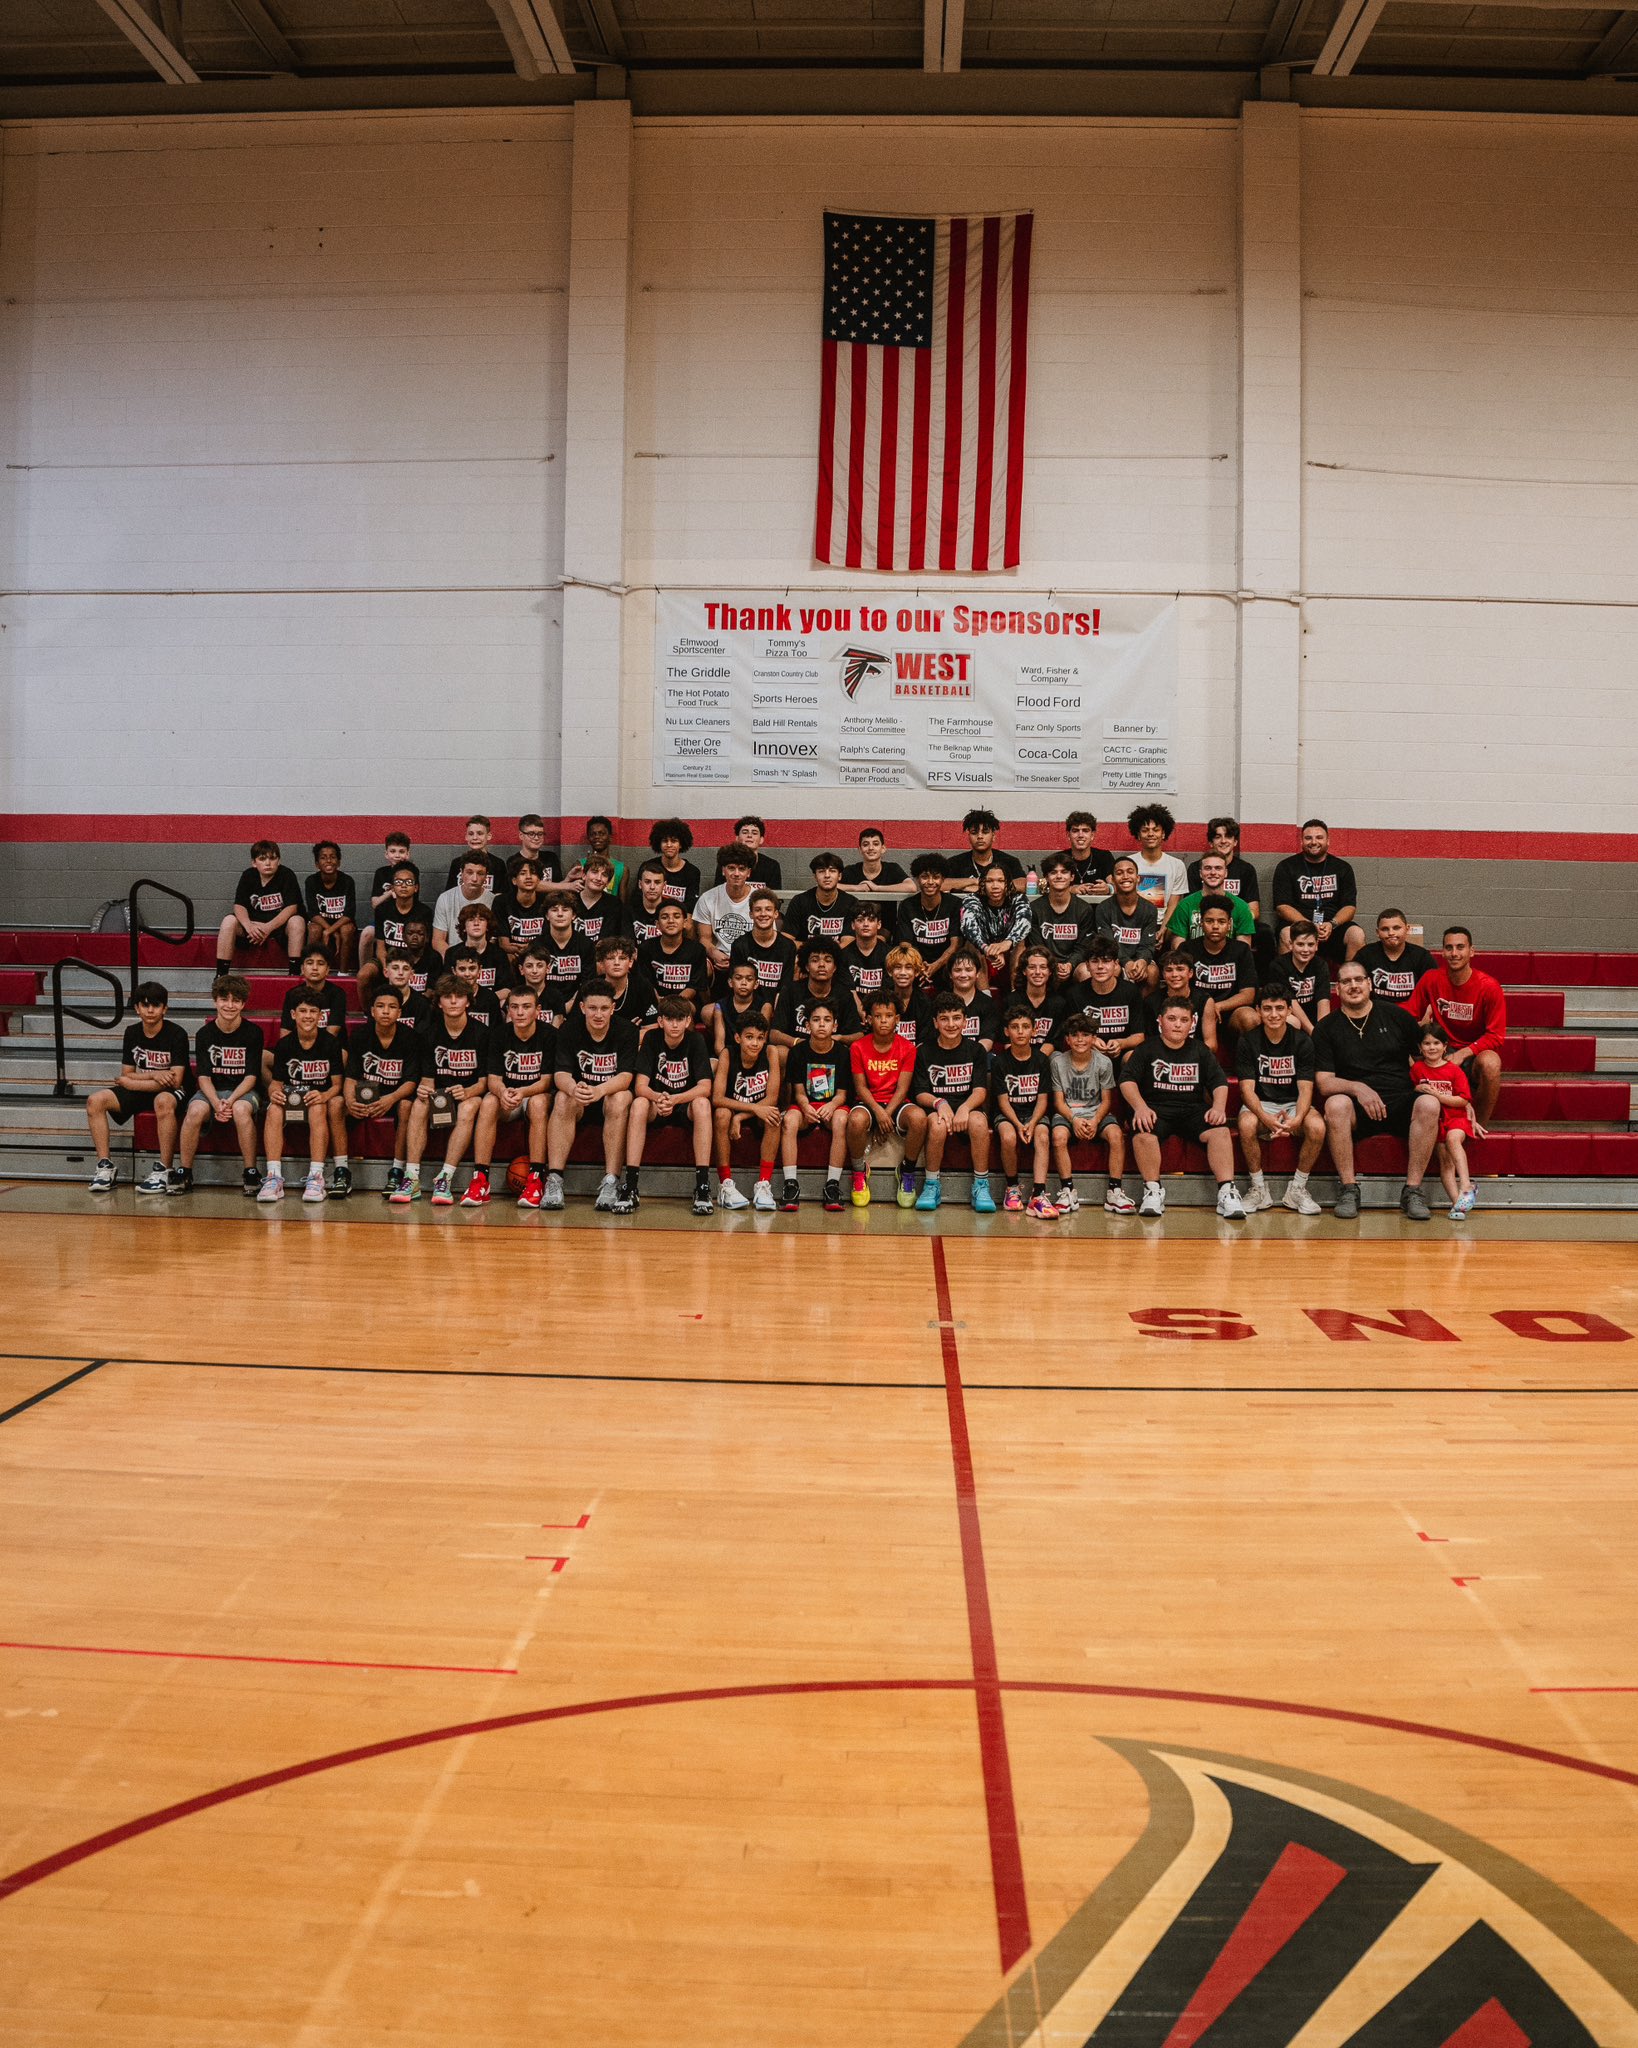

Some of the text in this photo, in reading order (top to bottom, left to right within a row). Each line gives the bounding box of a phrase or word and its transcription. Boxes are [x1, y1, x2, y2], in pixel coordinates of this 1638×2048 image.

[704, 603, 1100, 636] Thank you to our Sponsors!
[680, 638, 718, 646] Elmwood
[768, 639, 806, 648] Tommy's
[673, 646, 725, 654] Sportscenter
[896, 653, 971, 680] WEST
[667, 668, 730, 678] The Griddle
[781, 670, 804, 678] Country
[895, 685, 971, 696] BASKETBALL
[753, 694, 817, 704] Sports Heroes
[1017, 696, 1080, 707] Flood Ford
[1146, 725, 1158, 734] by:
[675, 738, 701, 746] Either
[677, 747, 718, 755] Jewelers
[754, 741, 818, 755] Innovex
[872, 746, 905, 755] Catering
[1018, 748, 1077, 759] Coca-Cola
[928, 772, 992, 782] RFS Visuals
[1224, 881, 1239, 890] EST
[1312, 876, 1335, 887] WEST
[664, 887, 686, 897] WEST
[260, 894, 282, 905] WEST
[326, 898, 344, 908] WES
[586, 919, 602, 930] WES
[928, 920, 949, 930] WEST
[1055, 925, 1076, 934] WEST
[560, 957, 580, 967] WEST
[666, 966, 690, 976] WEST
[760, 963, 784, 974] WEST
[1210, 965, 1235, 976] WEST
[409, 975, 427, 986] WES
[862, 970, 882, 980] WEST
[1389, 974, 1412, 984] WEST
[1196, 981, 1217, 989] SUMMER
[1301, 978, 1316, 989] EST
[539, 1012, 552, 1023] EST
[1102, 1008, 1128, 1018] WEST
[900, 1022, 916, 1033] WES
[147, 1052, 170, 1063] WEST
[223, 1048, 244, 1060] WES
[450, 1052, 476, 1062] WEST
[520, 1054, 542, 1066] WET
[868, 1060, 898, 1071] NIKE
[1271, 1057, 1293, 1069] WEST
[303, 1061, 330, 1074] WEST
[379, 1060, 402, 1072] WEST
[947, 1064, 973, 1077] WEST
[1172, 1064, 1198, 1076] WEST
[1020, 1077, 1039, 1088] WES
[1072, 1077, 1088, 1088] MY
[1154, 1082, 1178, 1091] SUMMER
[1066, 1089, 1096, 1100] RULES
